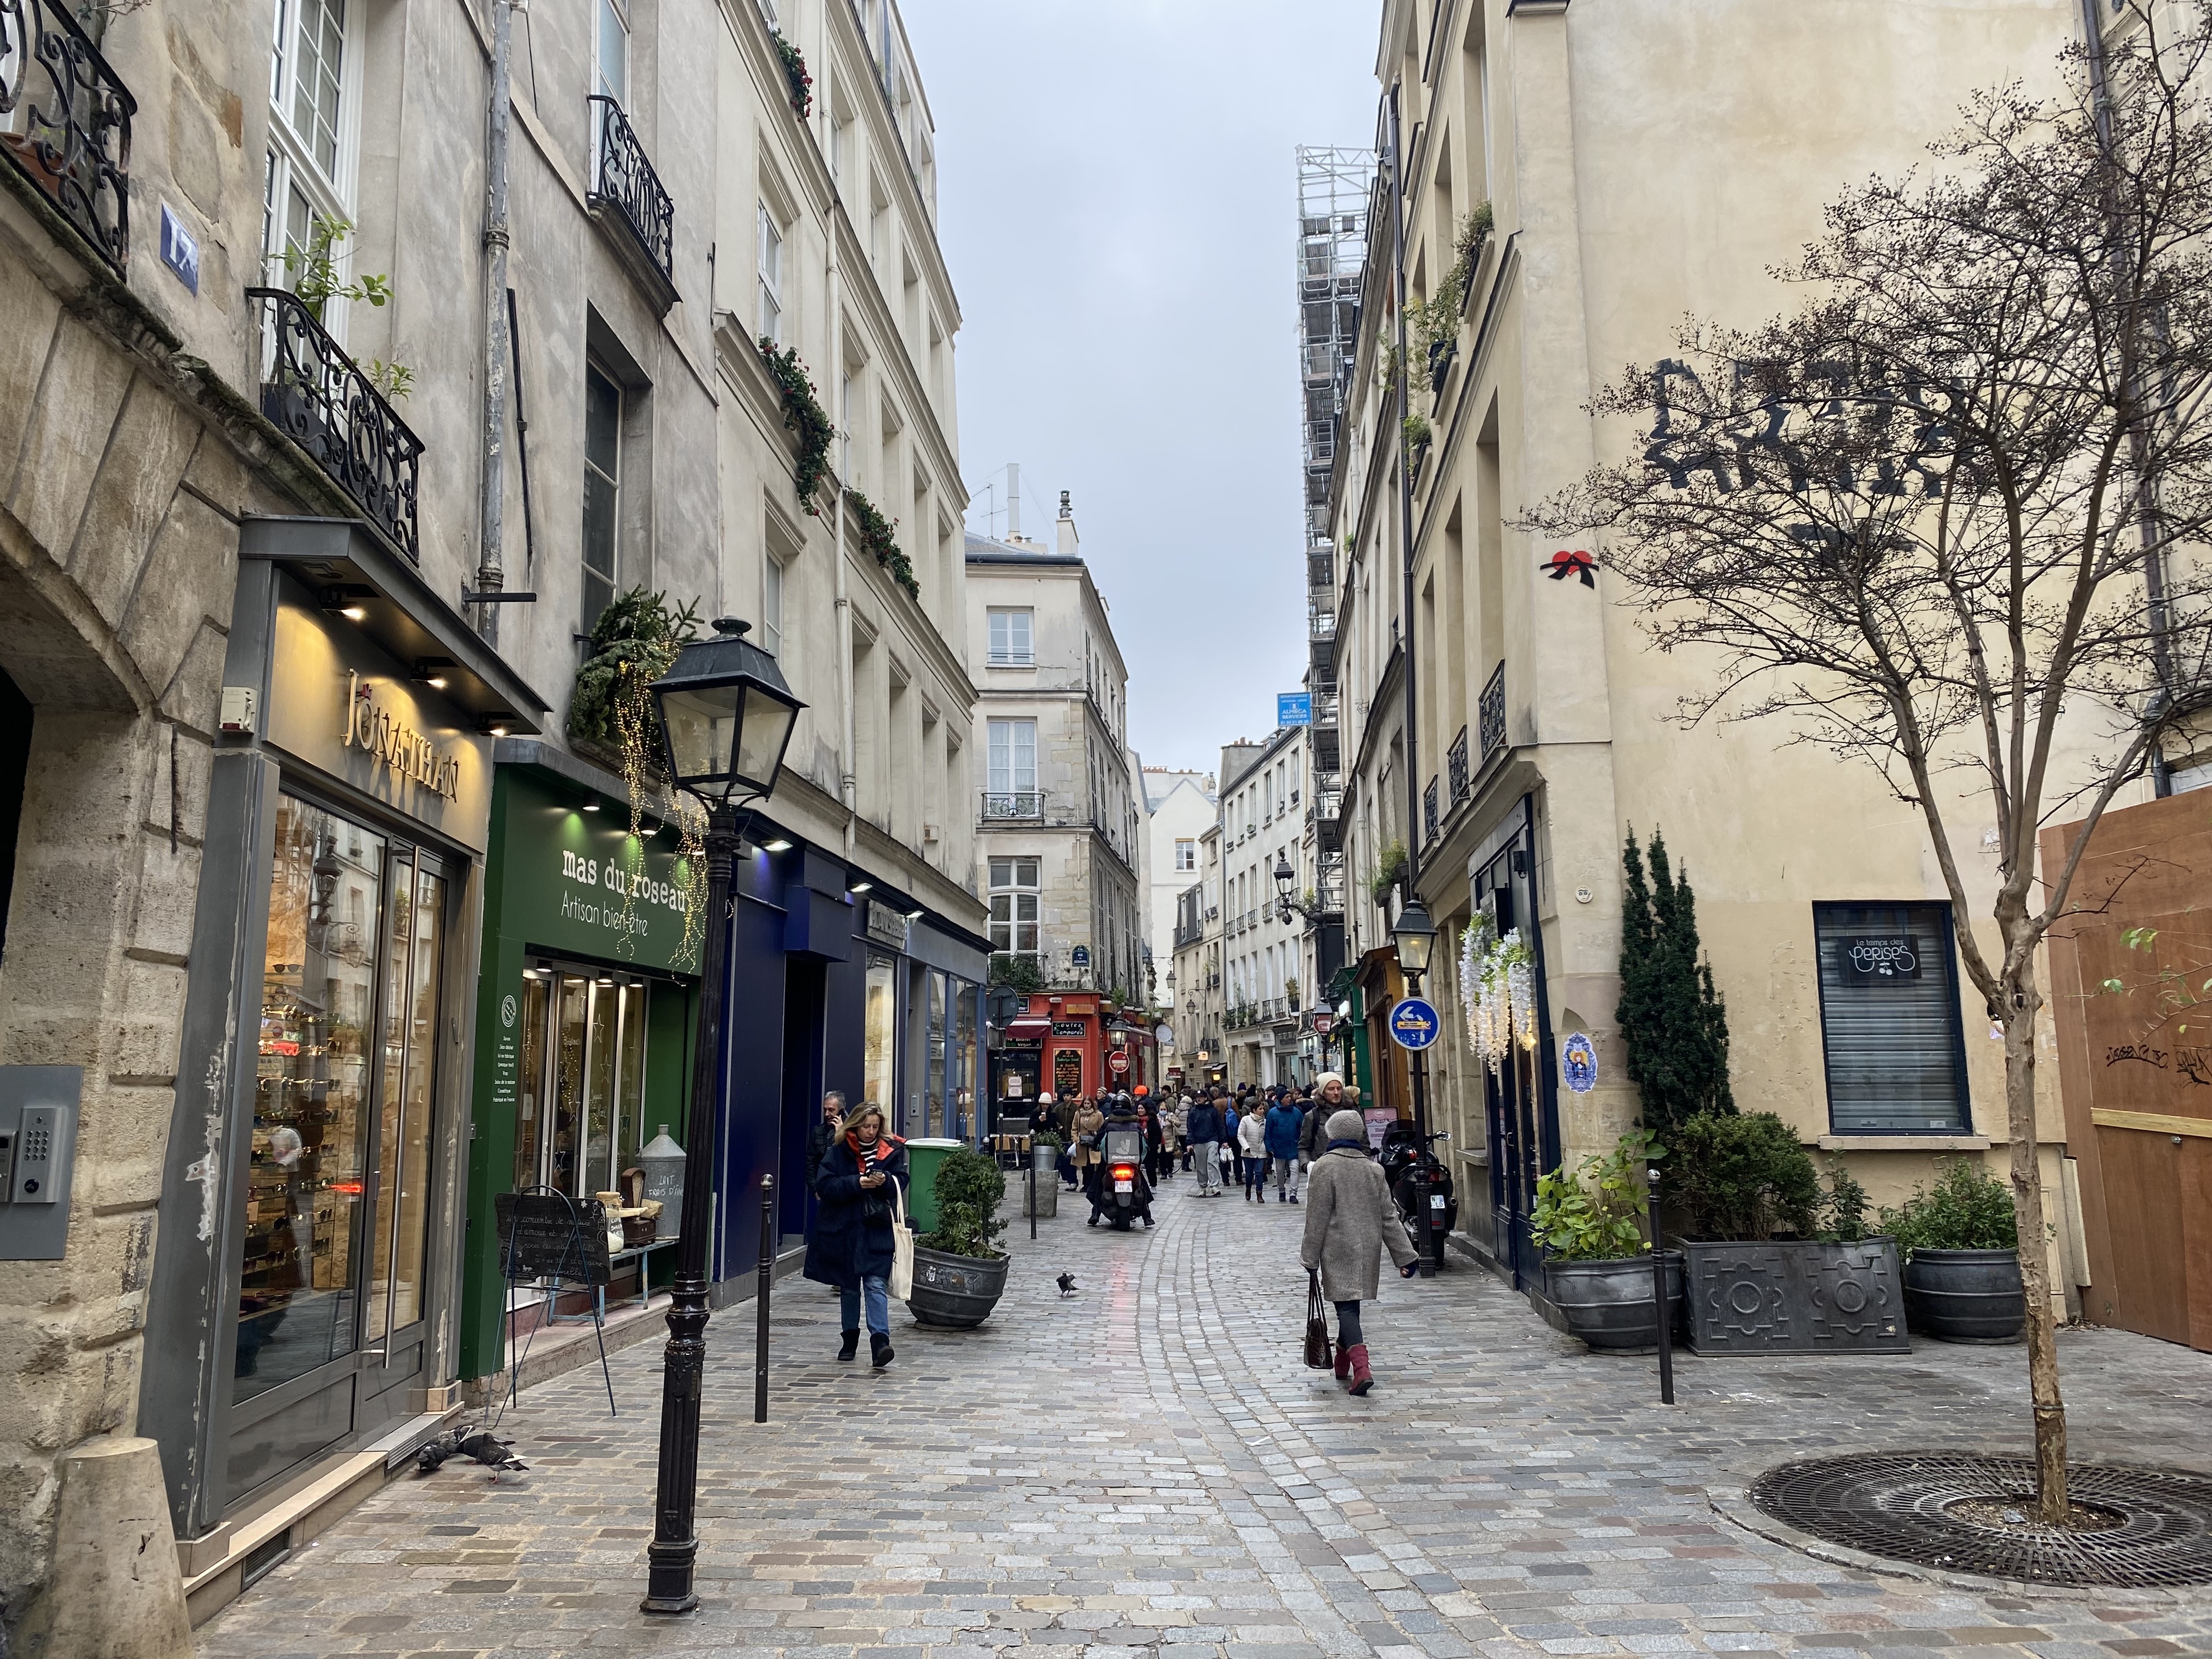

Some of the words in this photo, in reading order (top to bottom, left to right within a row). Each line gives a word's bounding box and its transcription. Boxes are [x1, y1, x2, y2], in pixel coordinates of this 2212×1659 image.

[170, 219, 192, 270] 17
[340, 668, 460, 803] JONATHAN
[562, 850, 597, 885] mas
[605, 857, 625, 895] du
[632, 873, 686, 913] roseau
[561, 889, 599, 925] Artisan
[648, 1188, 666, 1198] FRAIS
[659, 1175, 675, 1186] LAIT
